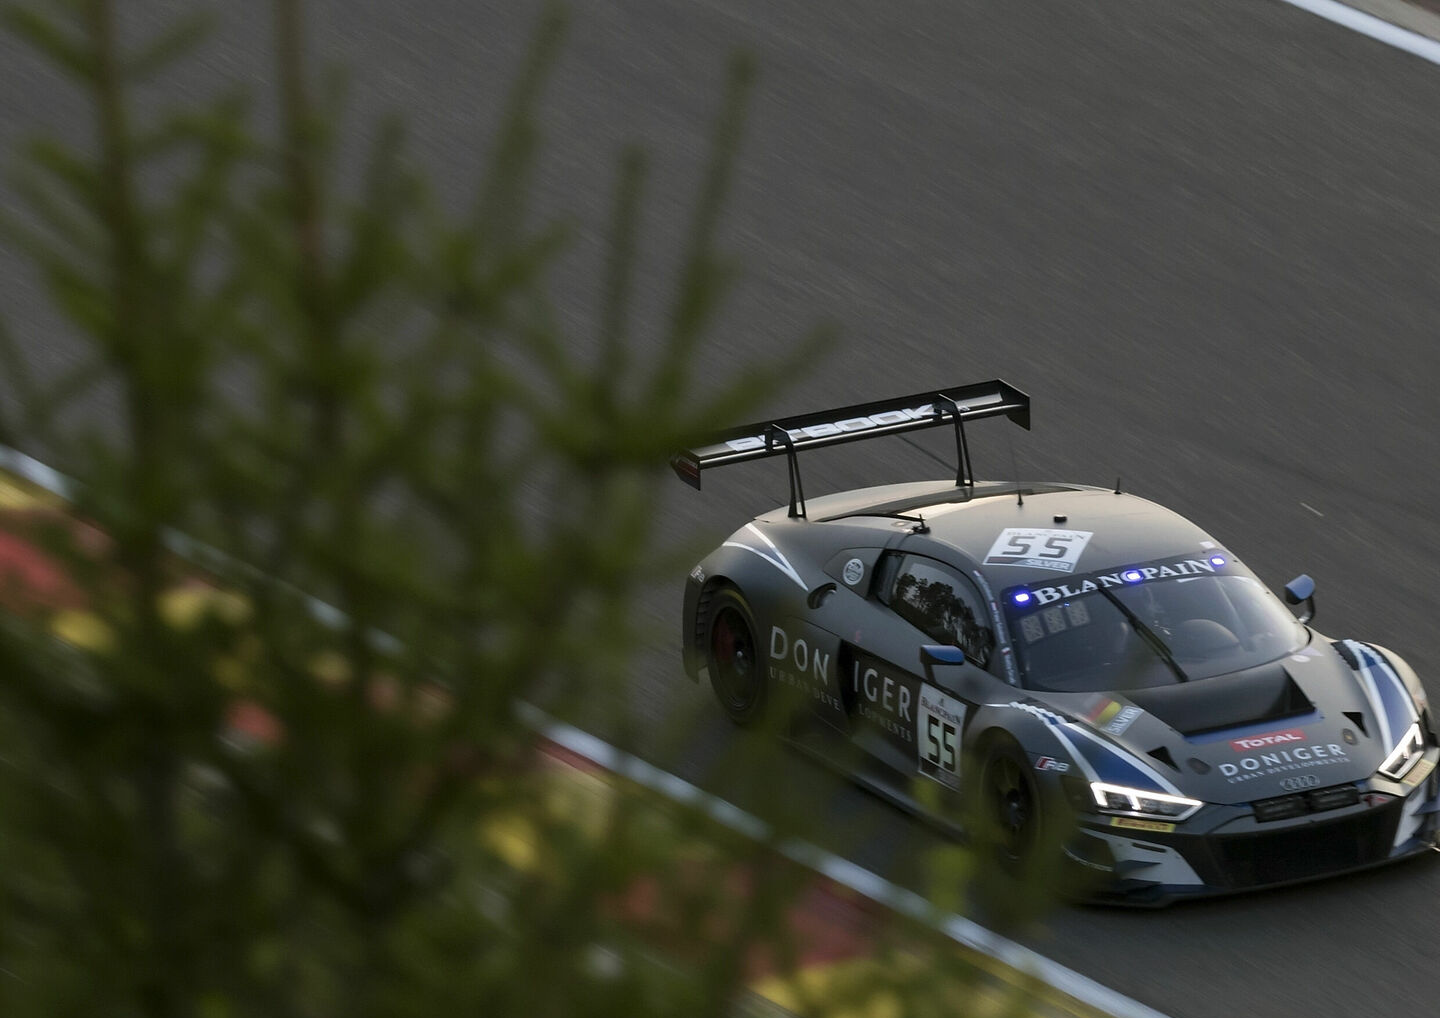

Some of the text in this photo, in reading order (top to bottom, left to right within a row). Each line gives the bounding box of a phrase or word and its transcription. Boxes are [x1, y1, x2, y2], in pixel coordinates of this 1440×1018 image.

[1001, 536, 1073, 558] 55
[1025, 558, 1069, 570] SILVER
[1108, 708, 1139, 733] SILVER
[928, 714, 955, 772] 55
[1234, 733, 1302, 749] TOTAL
[1218, 744, 1346, 776] DONIGER
